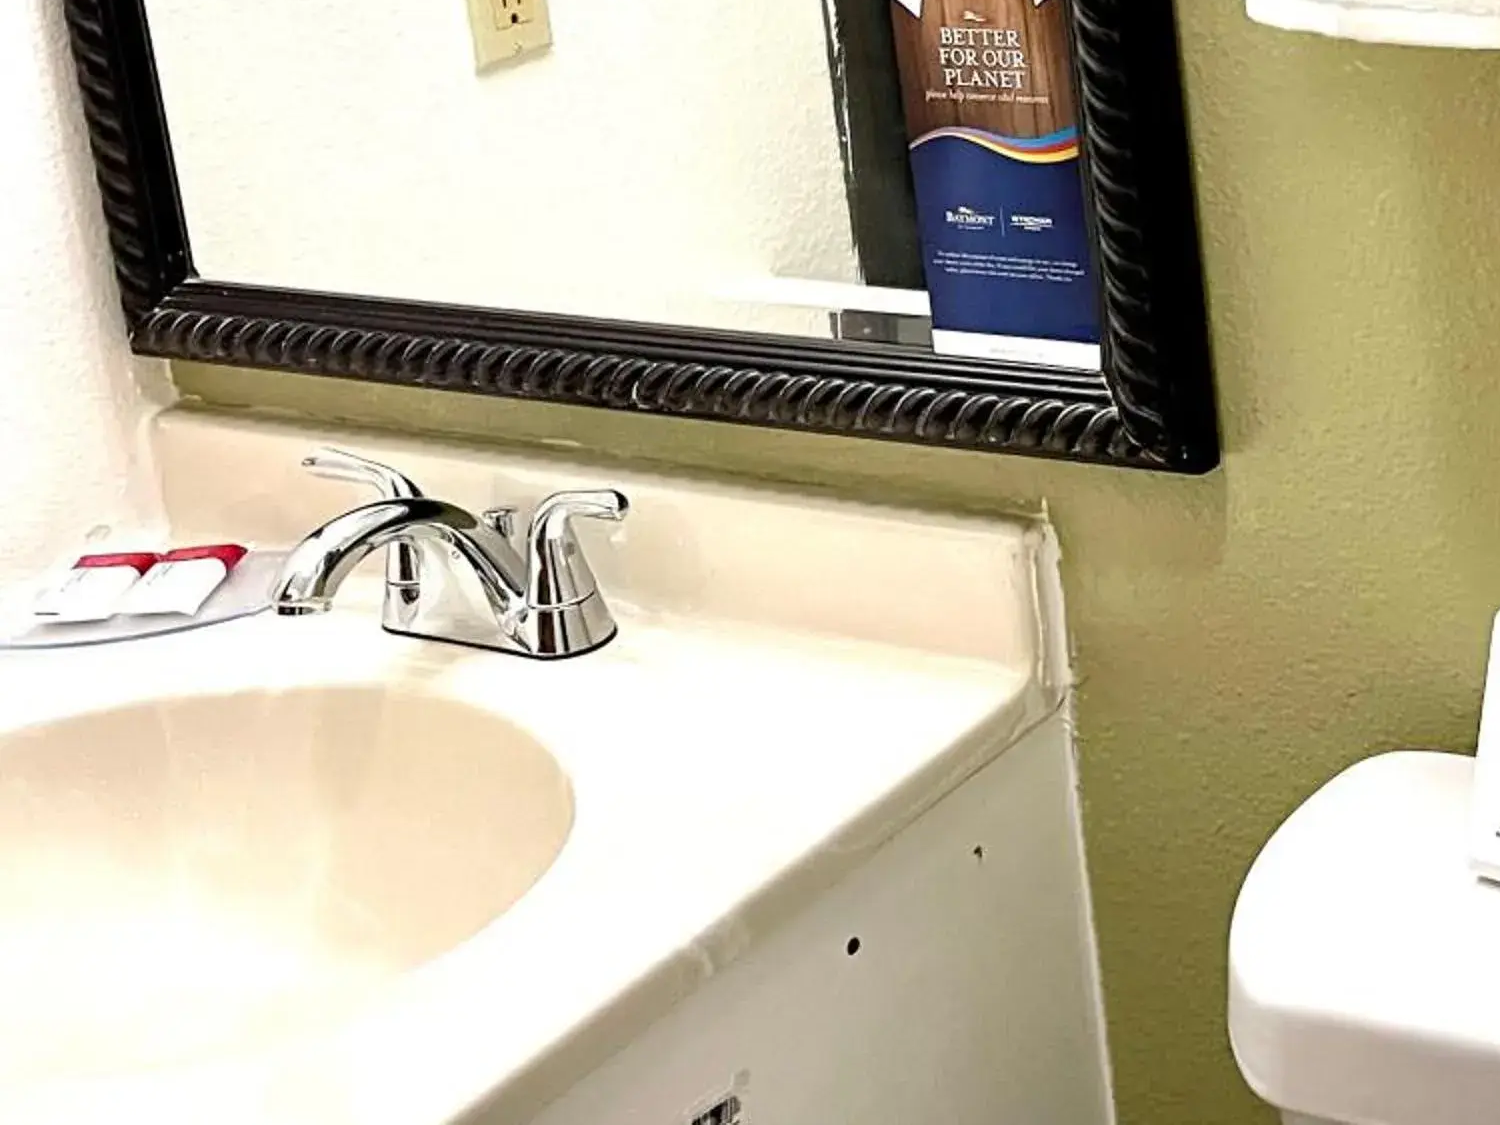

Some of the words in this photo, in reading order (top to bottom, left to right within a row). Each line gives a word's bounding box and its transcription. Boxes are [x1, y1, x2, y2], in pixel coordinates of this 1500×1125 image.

[940, 26, 1021, 47] BETTER
[938, 47, 979, 66] FOR
[982, 49, 1028, 68] OUR
[943, 68, 1026, 89] PLANET
